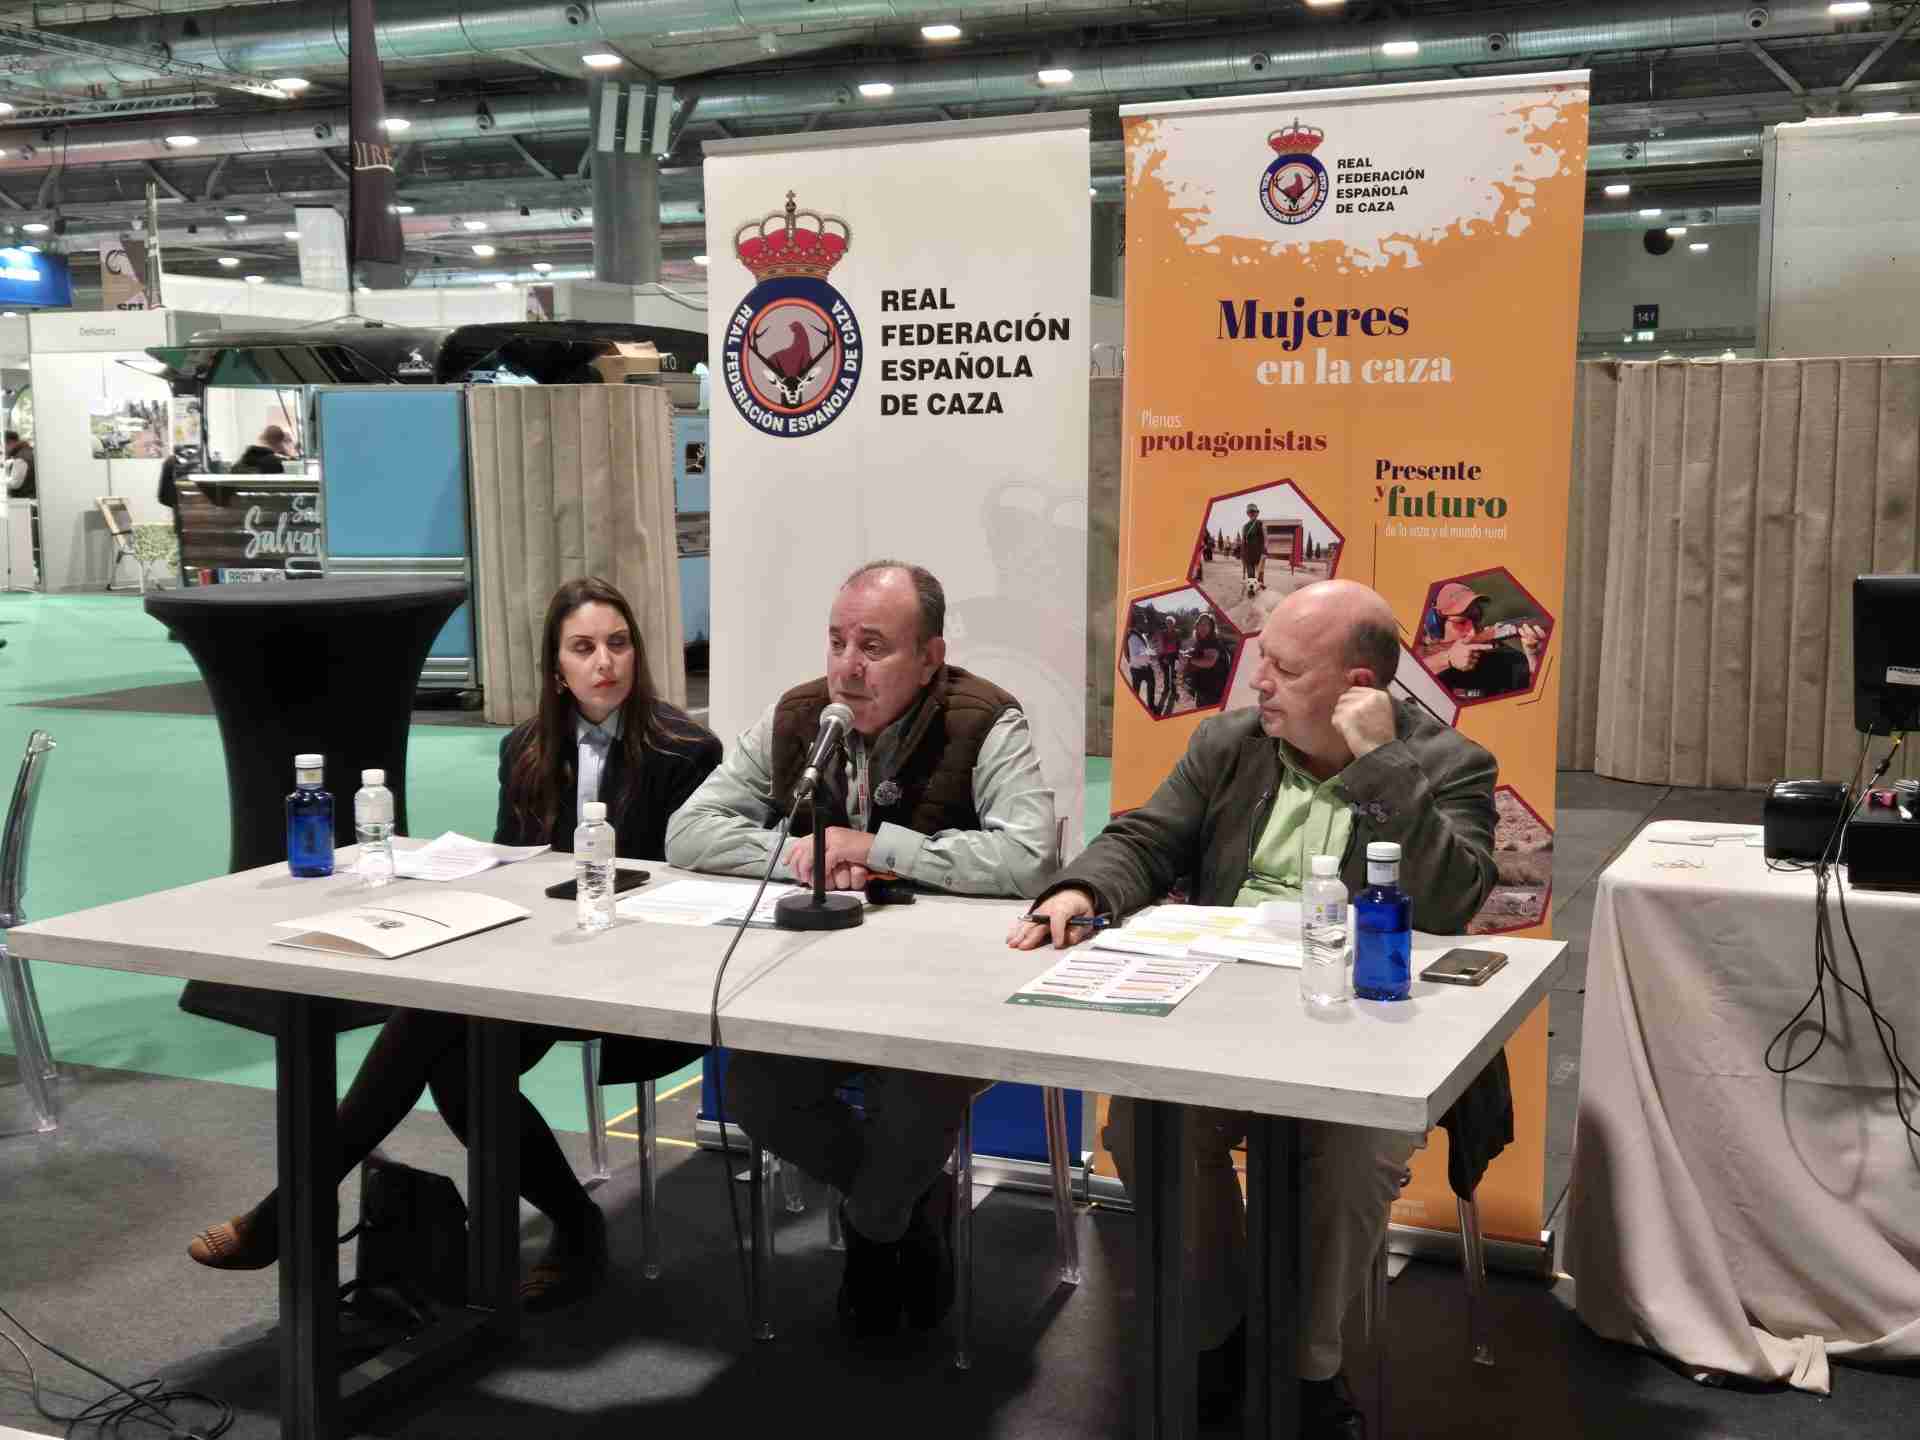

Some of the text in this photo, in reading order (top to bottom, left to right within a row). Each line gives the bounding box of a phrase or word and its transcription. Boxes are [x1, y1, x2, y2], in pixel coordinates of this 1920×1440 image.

[1337, 157, 1373, 169] REAL
[1337, 167, 1425, 184] FEDERACIÓN
[1336, 185, 1408, 199] ESPAÑOLA
[1336, 201, 1395, 214] DE CAZA
[881, 287, 955, 312] REAL
[881, 312, 1070, 347] FEDERACIÓN
[1215, 297, 1409, 351] Mujeres
[726, 300, 859, 433] REAL FEDERACIÓN ESPAÑOLA DE CAZA
[881, 351, 1033, 381] ESPAÑOLA
[1256, 347, 1453, 385] en la caza
[880, 391, 1004, 416] DE CAZA
[1140, 428, 1328, 458] protagonistas
[1376, 459, 1482, 480] Presente
[1374, 485, 1508, 519] y futuro
